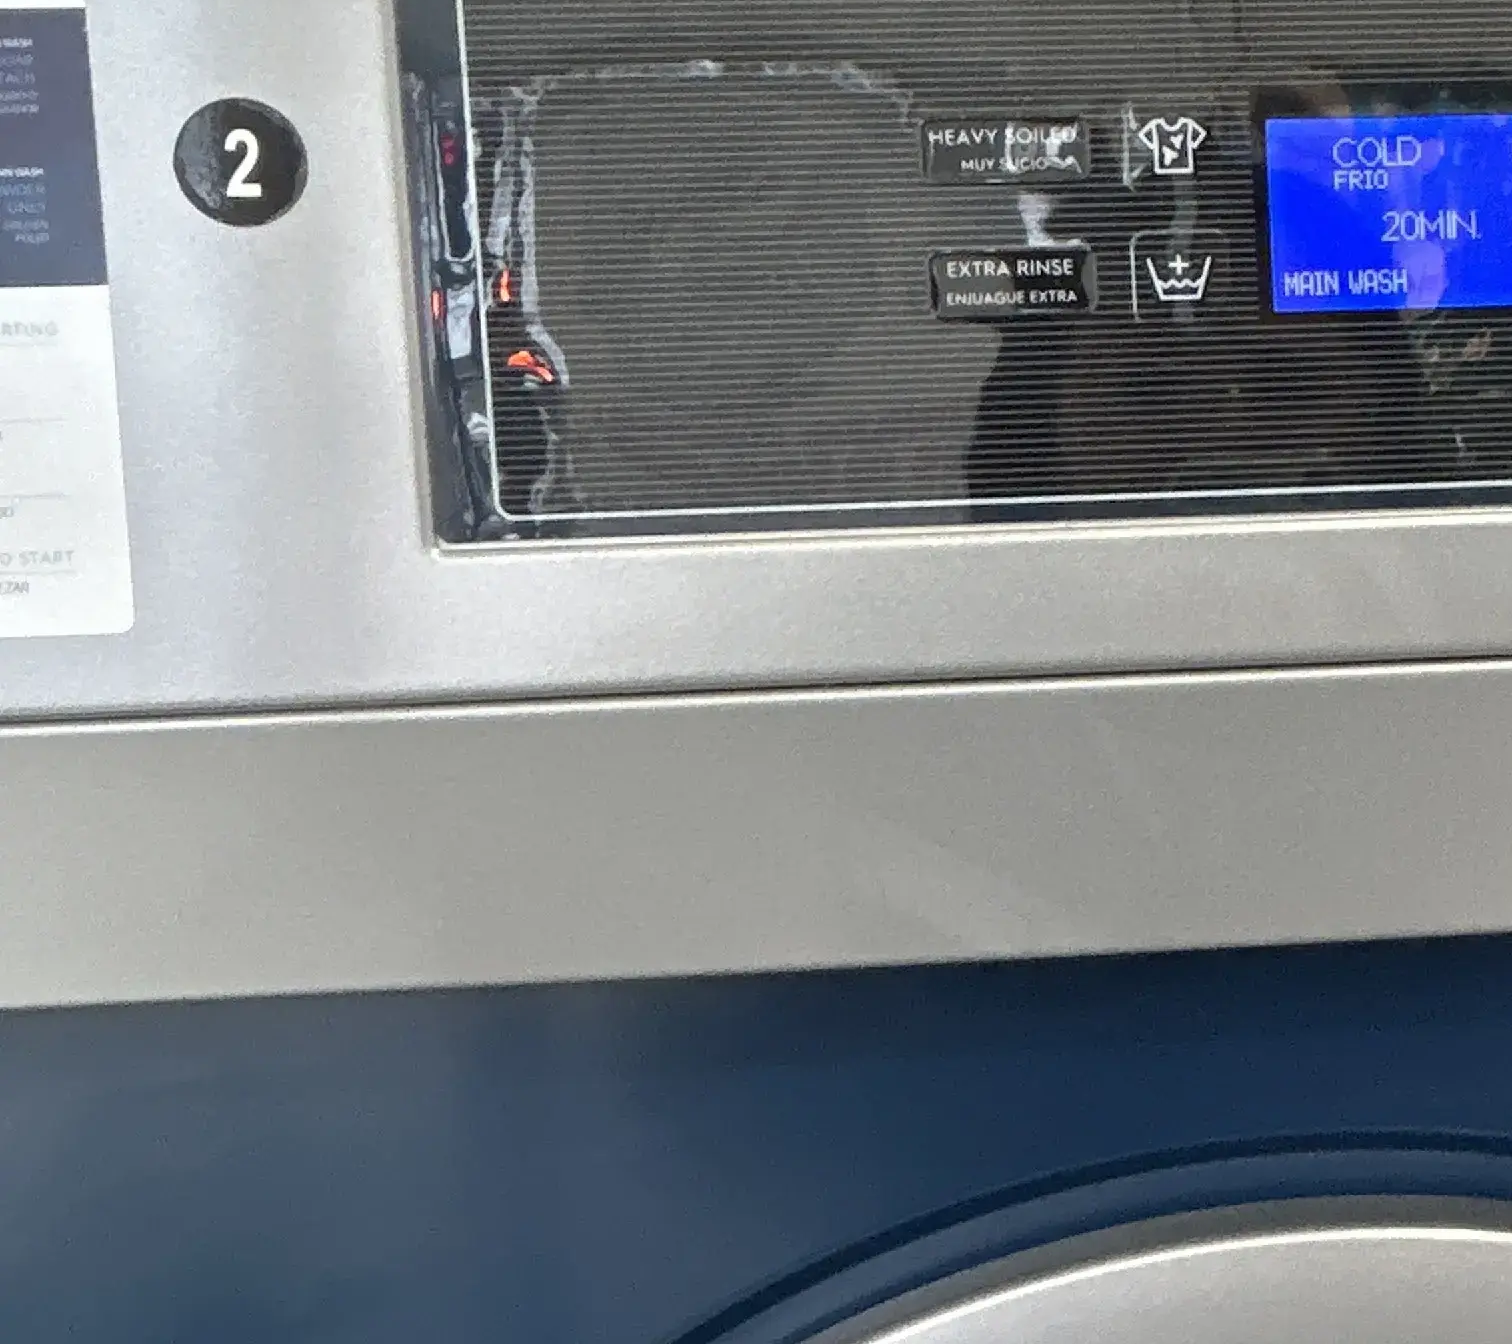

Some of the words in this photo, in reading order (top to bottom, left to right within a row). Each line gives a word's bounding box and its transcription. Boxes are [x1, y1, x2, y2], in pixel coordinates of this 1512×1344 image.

[928, 128, 997, 146] HEAVY
[1332, 136, 1422, 167] COLD
[224, 128, 263, 198] 2
[960, 158, 995, 172] MUY
[1333, 169, 1389, 190] FRIO
[946, 260, 1011, 278] EXTRA
[1016, 258, 1074, 276] RINSE
[1284, 270, 1340, 296] MAIN
[1348, 268, 1408, 294] WASH
[946, 290, 1026, 306] ENJUAGUE
[1029, 288, 1077, 304] EXTRA
